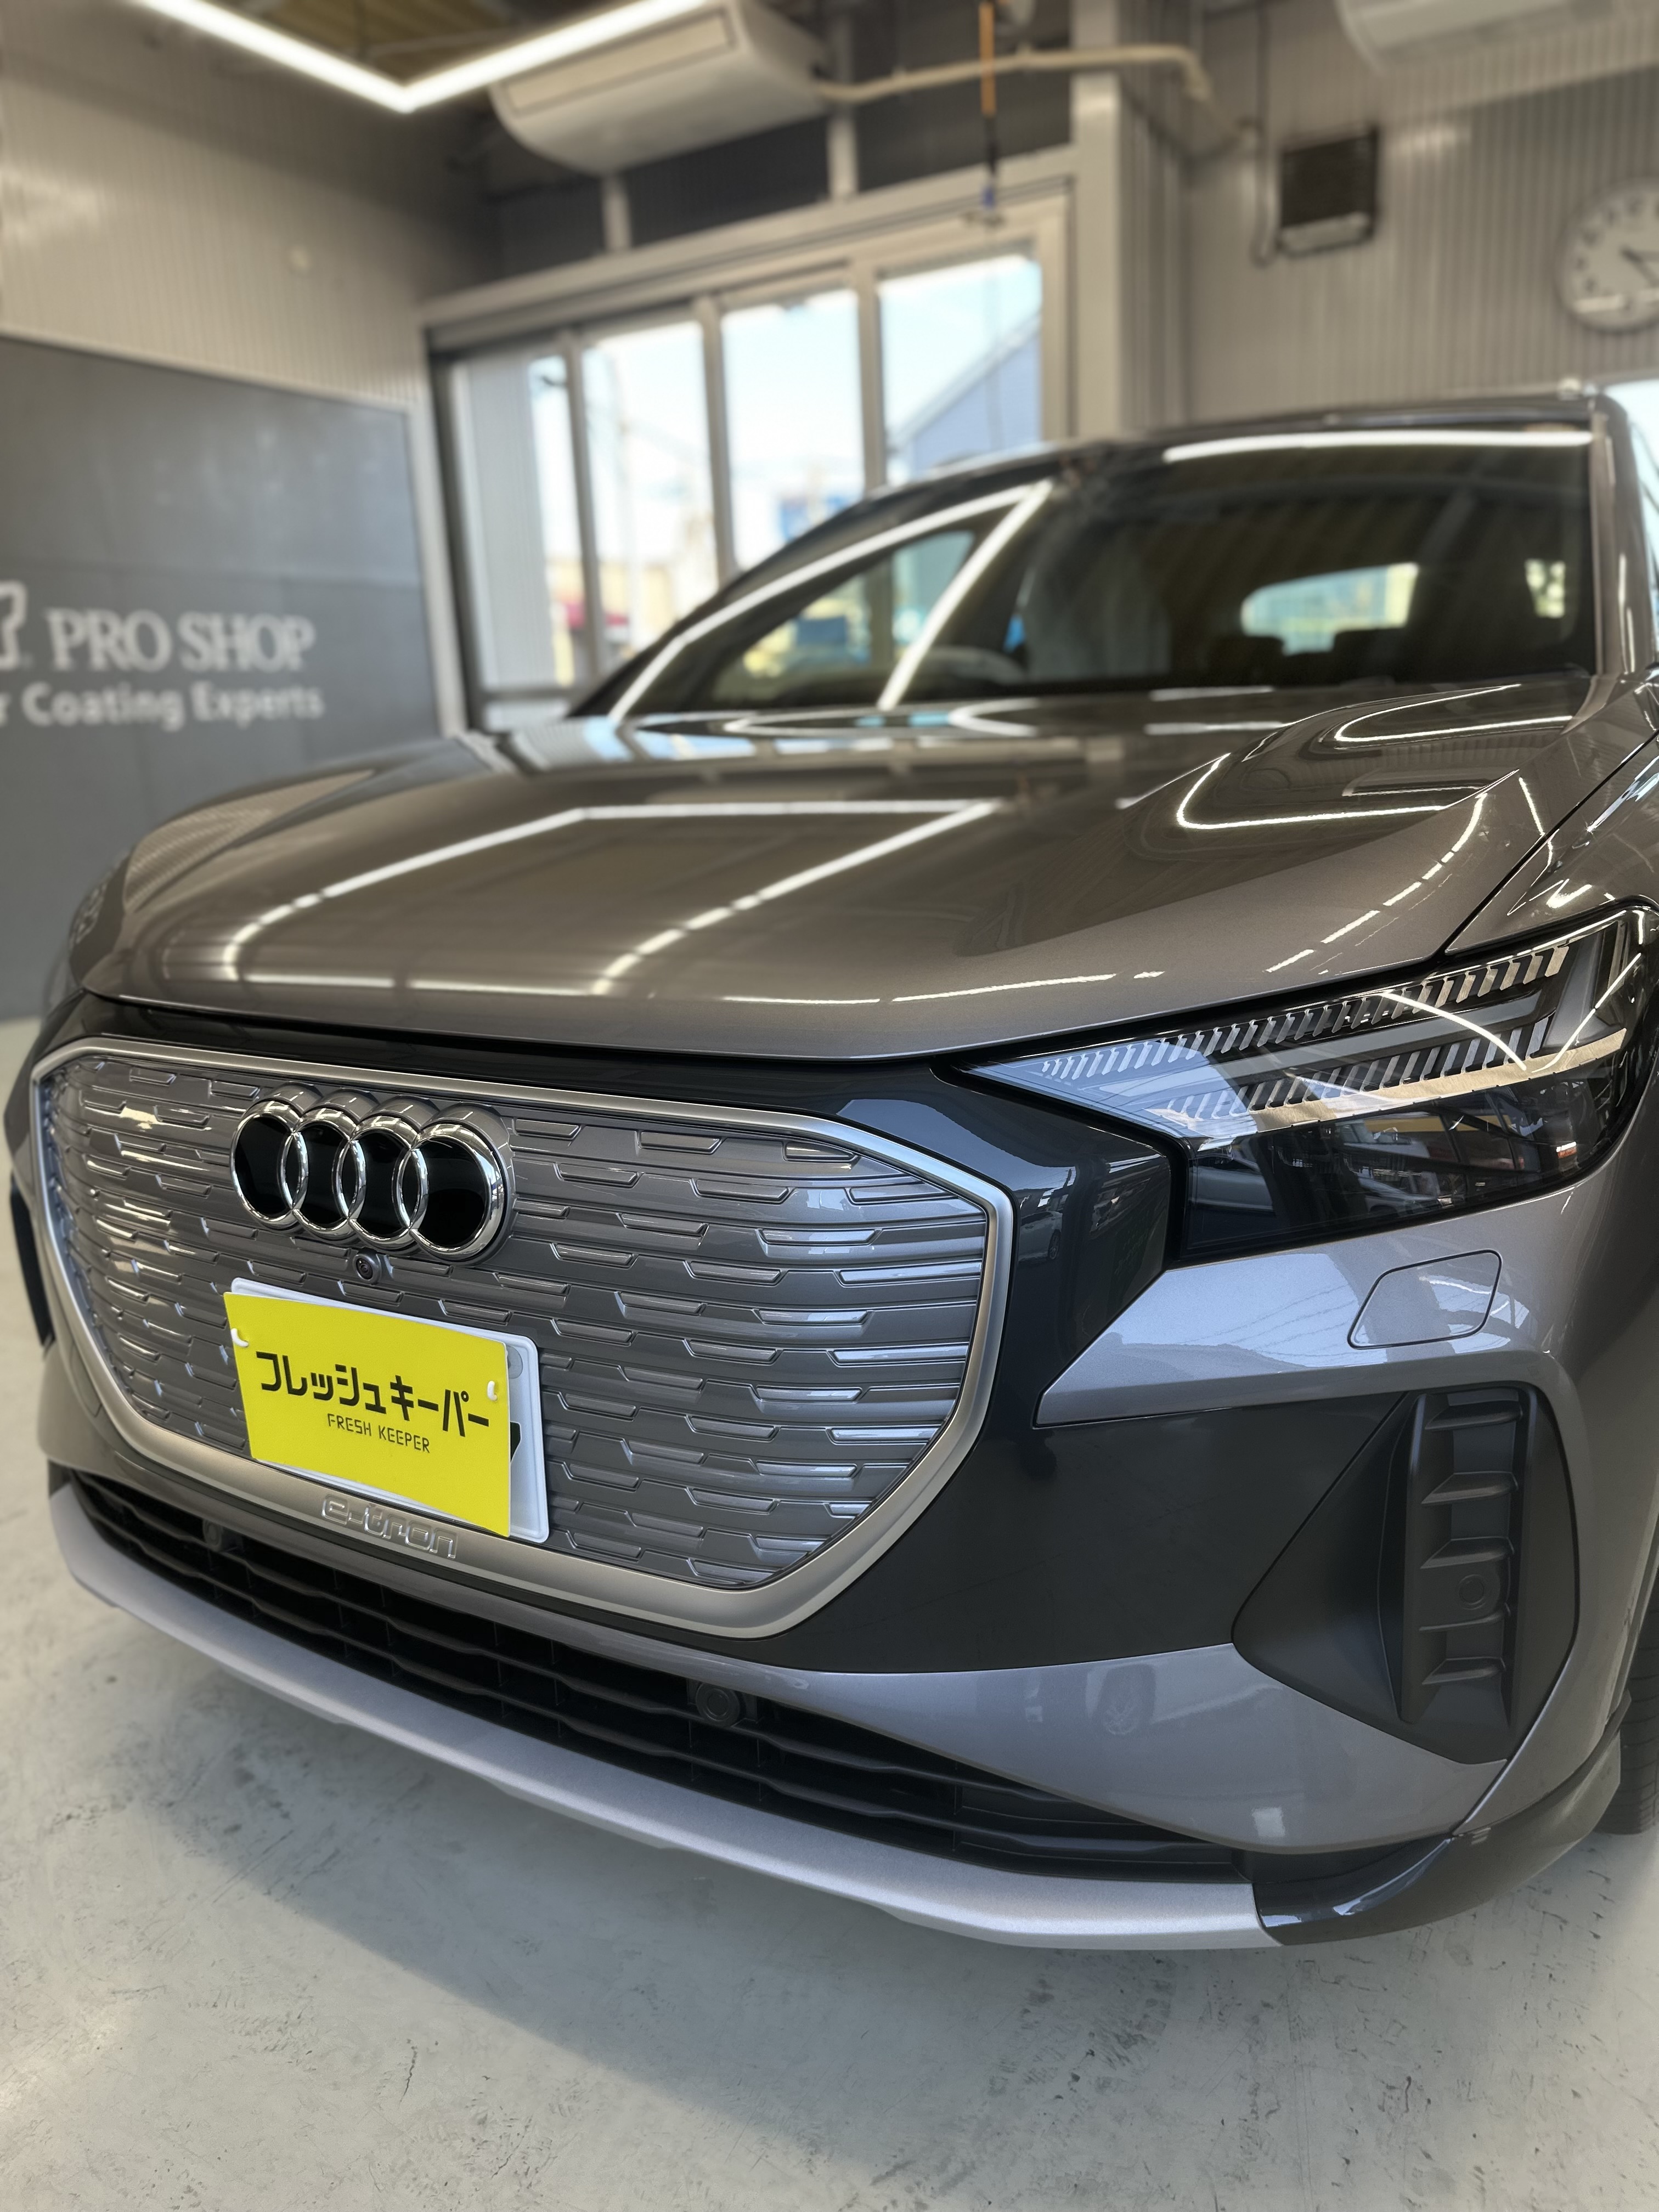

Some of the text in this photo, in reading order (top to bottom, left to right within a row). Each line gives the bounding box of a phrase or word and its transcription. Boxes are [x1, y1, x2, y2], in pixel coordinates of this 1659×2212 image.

[46, 608, 172, 672] PRO
[177, 610, 316, 673] SHOP
[22, 681, 184, 731] Coating
[190, 680, 324, 729] Experts
[256, 1351, 489, 1437] フレッシュキーパー
[328, 1413, 430, 1453] FRESH KEEPER
[322, 1494, 458, 1559] e-tron
